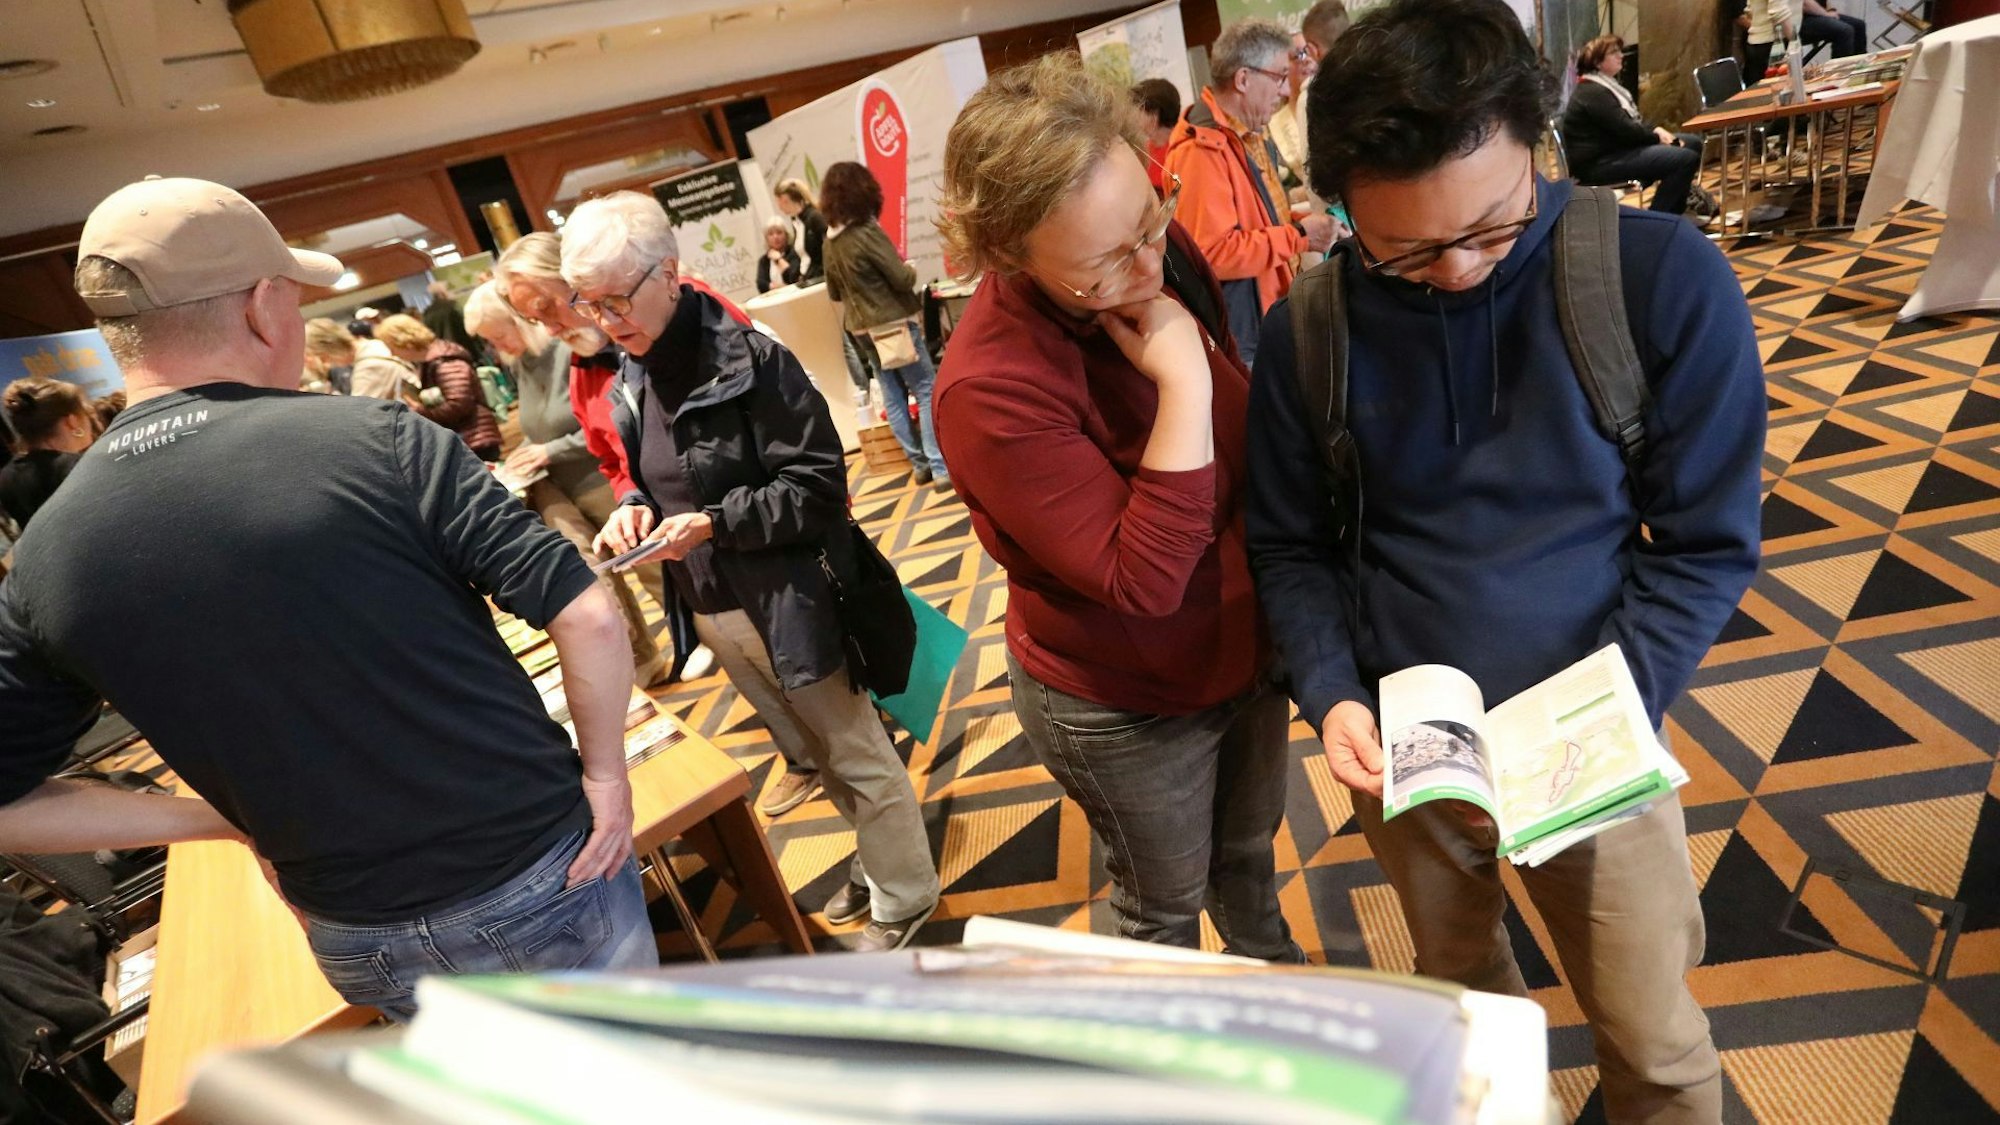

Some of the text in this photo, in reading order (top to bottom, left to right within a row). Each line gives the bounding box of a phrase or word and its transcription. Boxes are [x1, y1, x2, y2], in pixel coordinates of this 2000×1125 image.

[876, 113, 897, 139] APFEL
[667, 182, 735, 208] Messeangebote
[677, 175, 718, 194] Exklusive
[695, 247, 753, 273] SAUNA
[107, 410, 208, 454] MOUNTAIN
[132, 433, 176, 455] LOVERS
